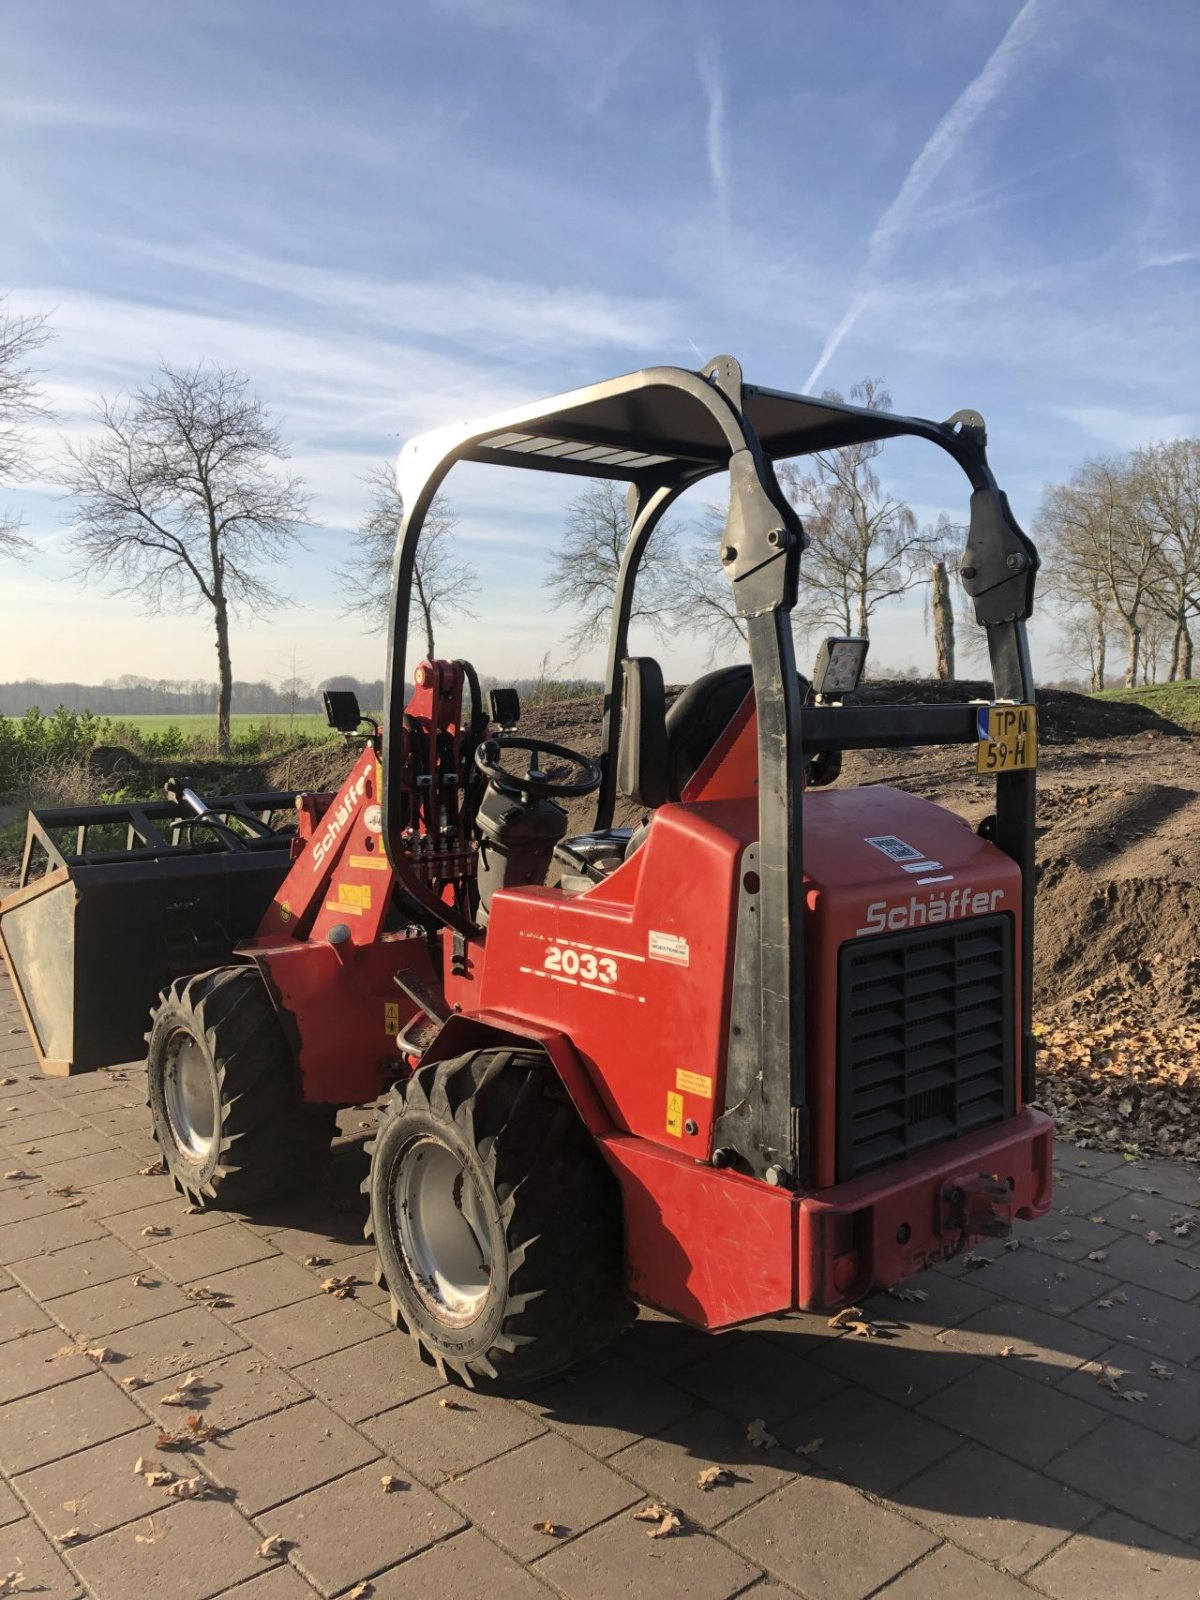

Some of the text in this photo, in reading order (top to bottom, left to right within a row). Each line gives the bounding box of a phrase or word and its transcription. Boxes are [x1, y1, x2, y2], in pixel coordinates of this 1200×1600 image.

[995, 710, 1028, 736] TPN
[986, 740, 1026, 768] 59-H
[313, 764, 372, 872] Schäffer
[855, 888, 1004, 935] Schäffer
[544, 945, 618, 984] 2033
